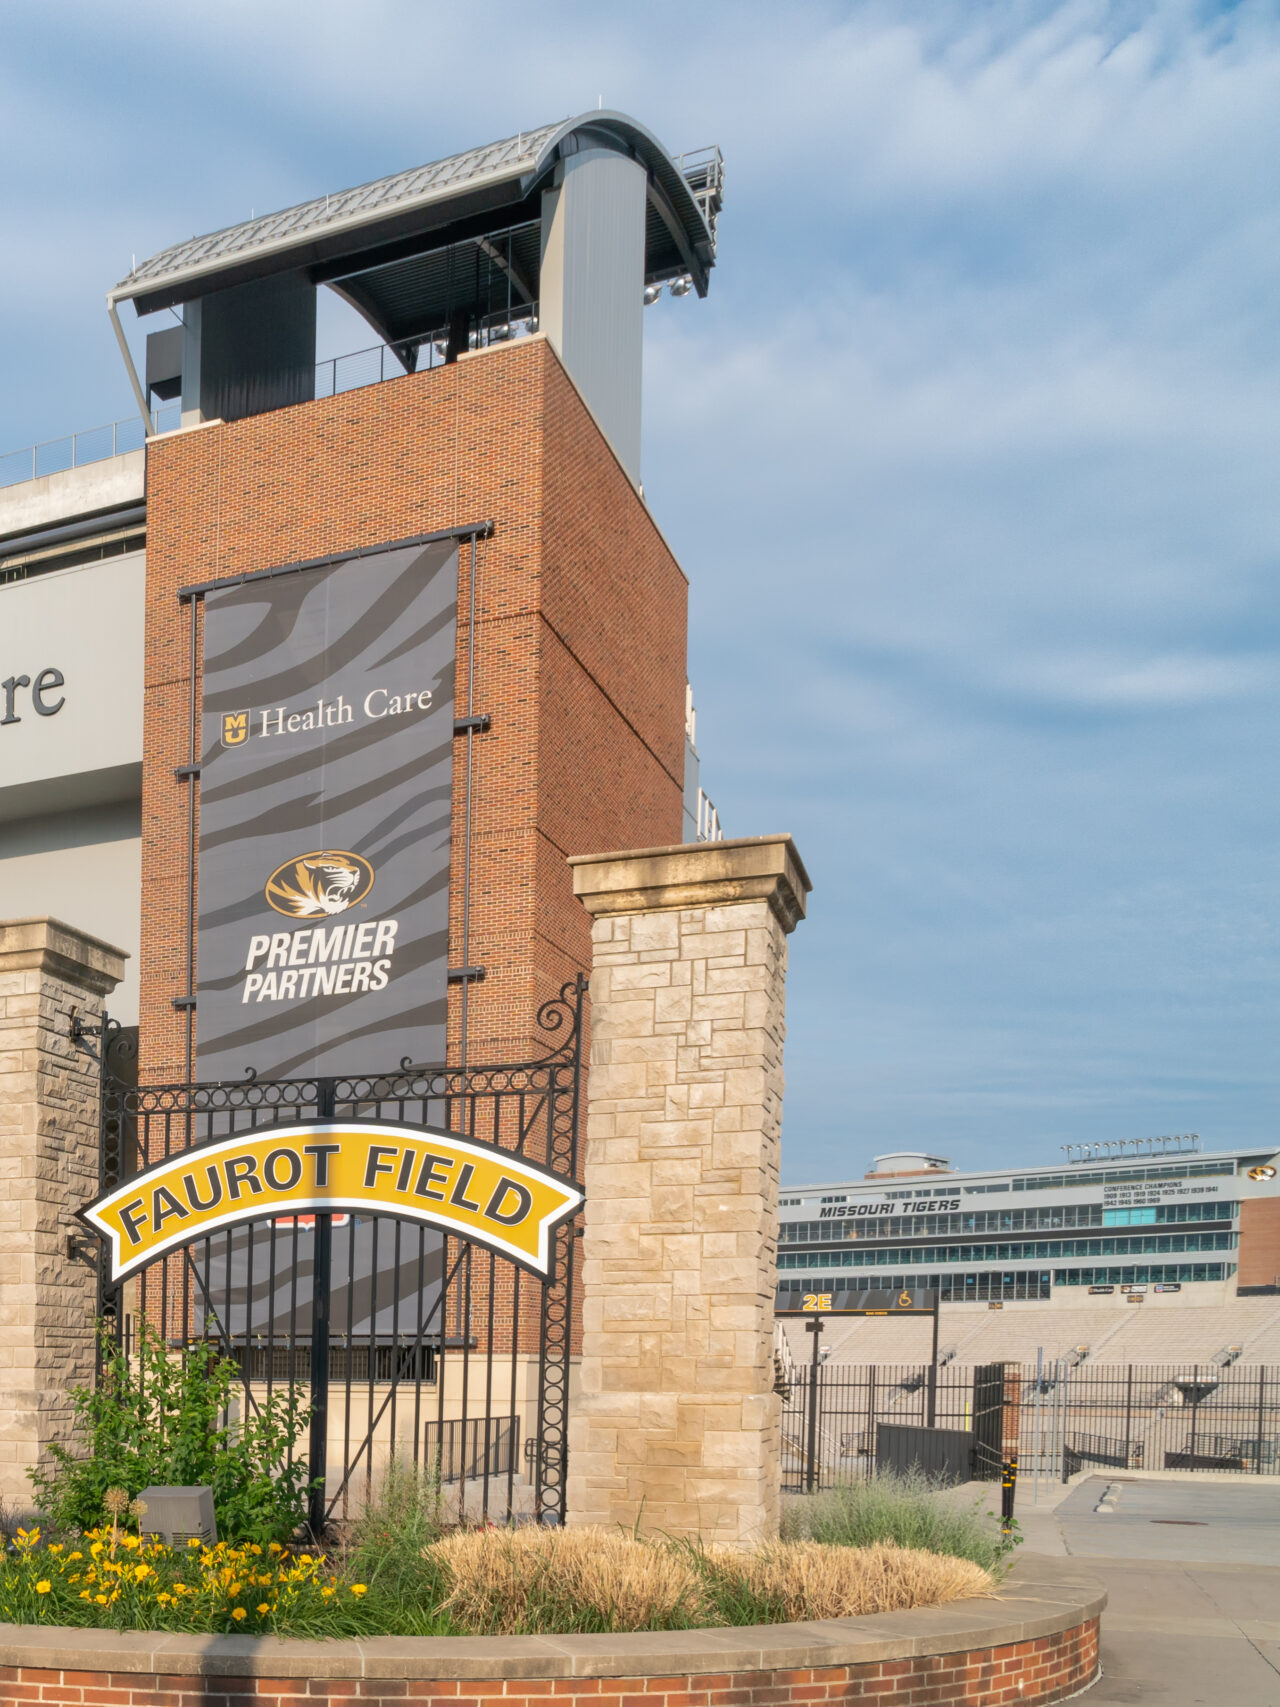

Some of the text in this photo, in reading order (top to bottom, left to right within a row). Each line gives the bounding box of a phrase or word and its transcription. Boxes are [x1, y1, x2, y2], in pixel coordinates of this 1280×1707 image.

[258, 695, 354, 738] Health
[363, 688, 432, 719] Care
[245, 919, 398, 971] PREMIER
[241, 959, 392, 1004] PARTNERS
[117, 1143, 533, 1246] FAUROT FIELD
[819, 1199, 961, 1218] MISSOURI TIGERS
[1103, 1181, 1182, 1192] CONFERENCE CHAMPIONS
[802, 1293, 832, 1311] 2E
